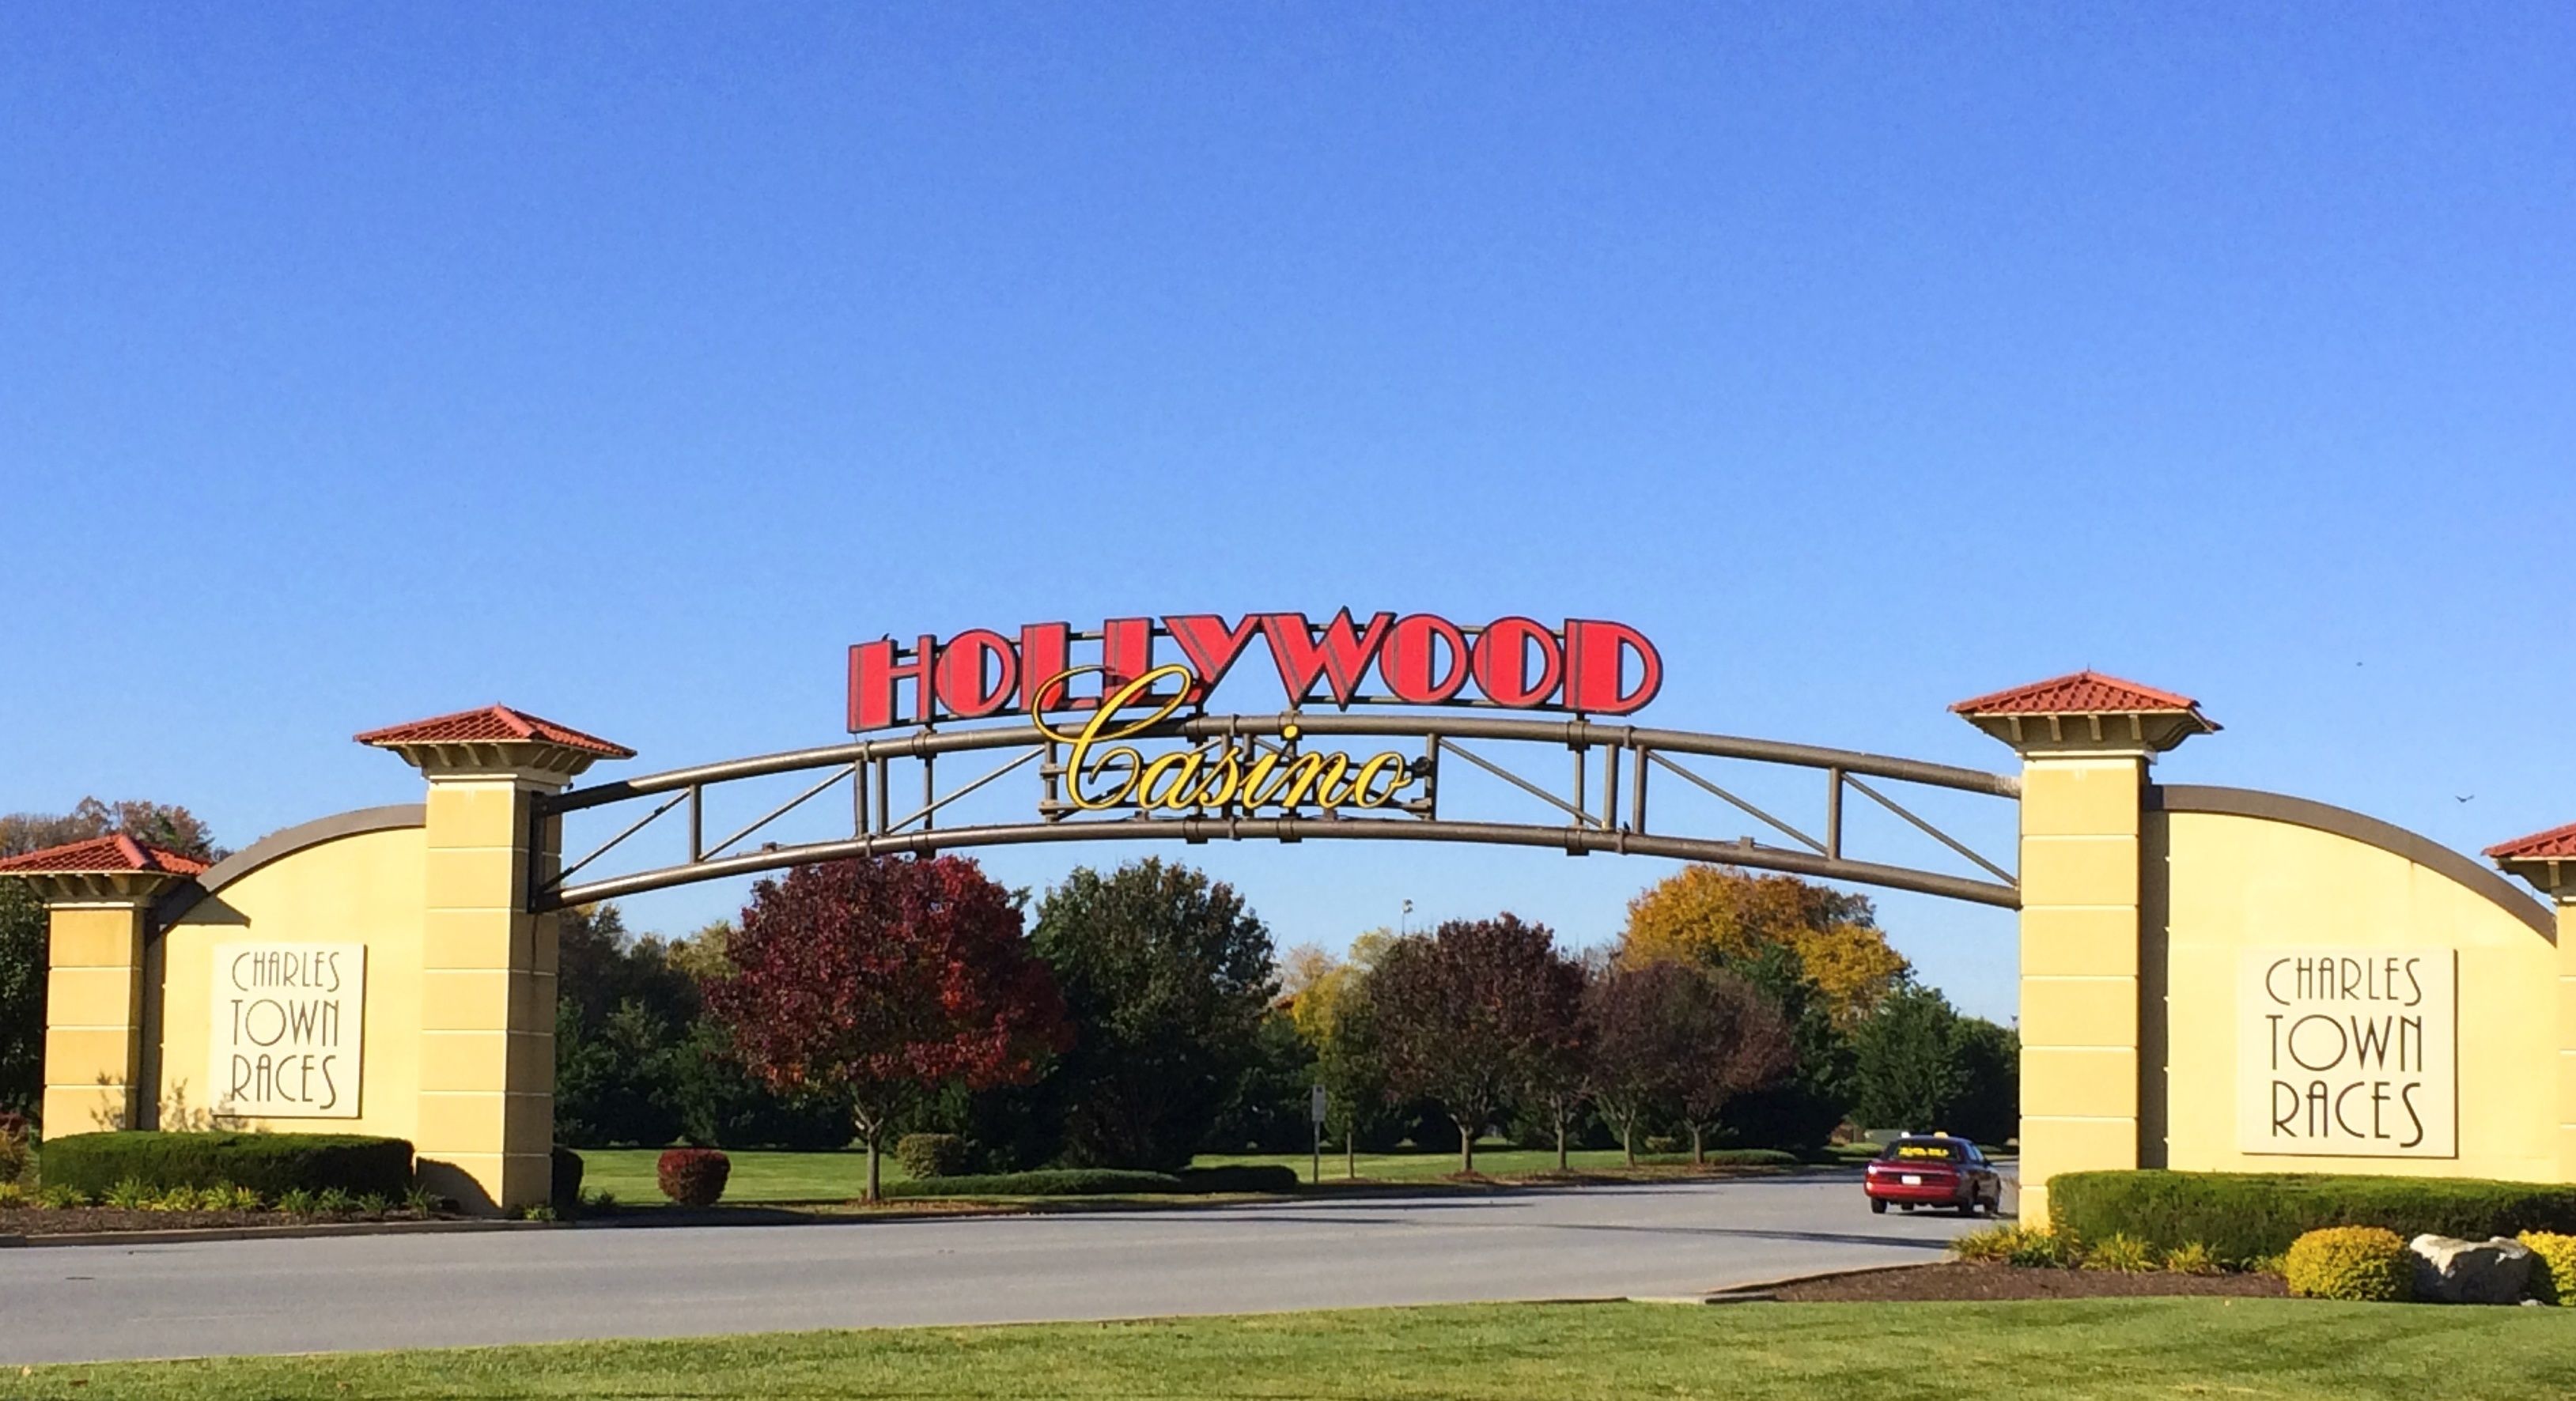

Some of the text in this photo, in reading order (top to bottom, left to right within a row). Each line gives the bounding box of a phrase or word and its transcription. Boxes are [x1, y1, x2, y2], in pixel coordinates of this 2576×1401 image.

[848, 606, 1663, 733] HOLLYWOOD
[1033, 664, 1414, 811] Casino
[232, 951, 340, 993] CHARLES
[2265, 957, 2423, 1007] CHARLES
[230, 999, 340, 1047] TOWN
[2265, 1014, 2423, 1072] TOWN
[231, 1053, 337, 1111] RACES
[2271, 1080, 2424, 1149] RACES
